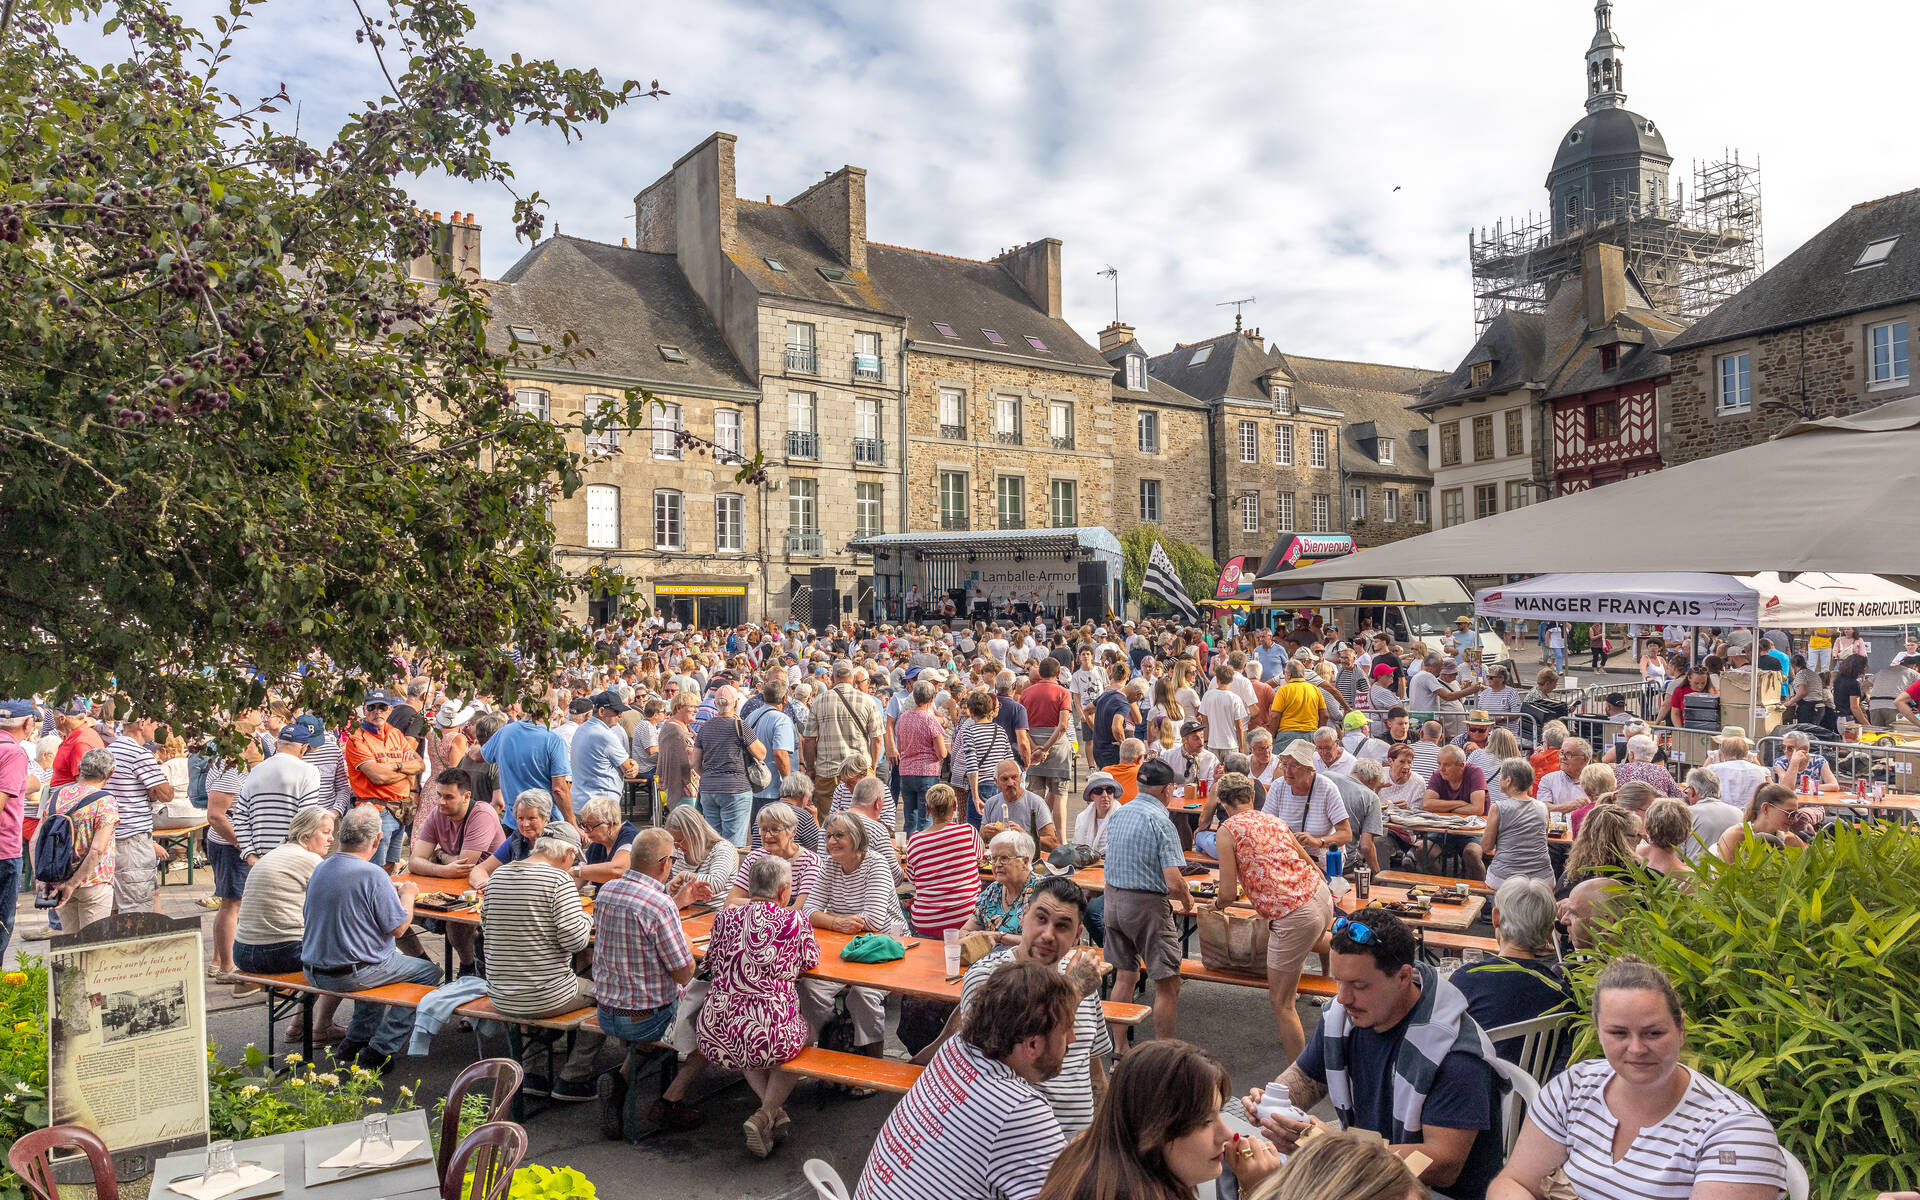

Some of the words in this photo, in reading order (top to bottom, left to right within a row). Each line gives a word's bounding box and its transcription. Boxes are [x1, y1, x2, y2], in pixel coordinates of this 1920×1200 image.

[1303, 538, 1350, 553] Bienvenue
[840, 568, 857, 576] Coast
[1514, 597, 1592, 613] MANGER
[1598, 598, 1702, 617] FRANÇAIS
[1815, 602, 1855, 617] JEUNES
